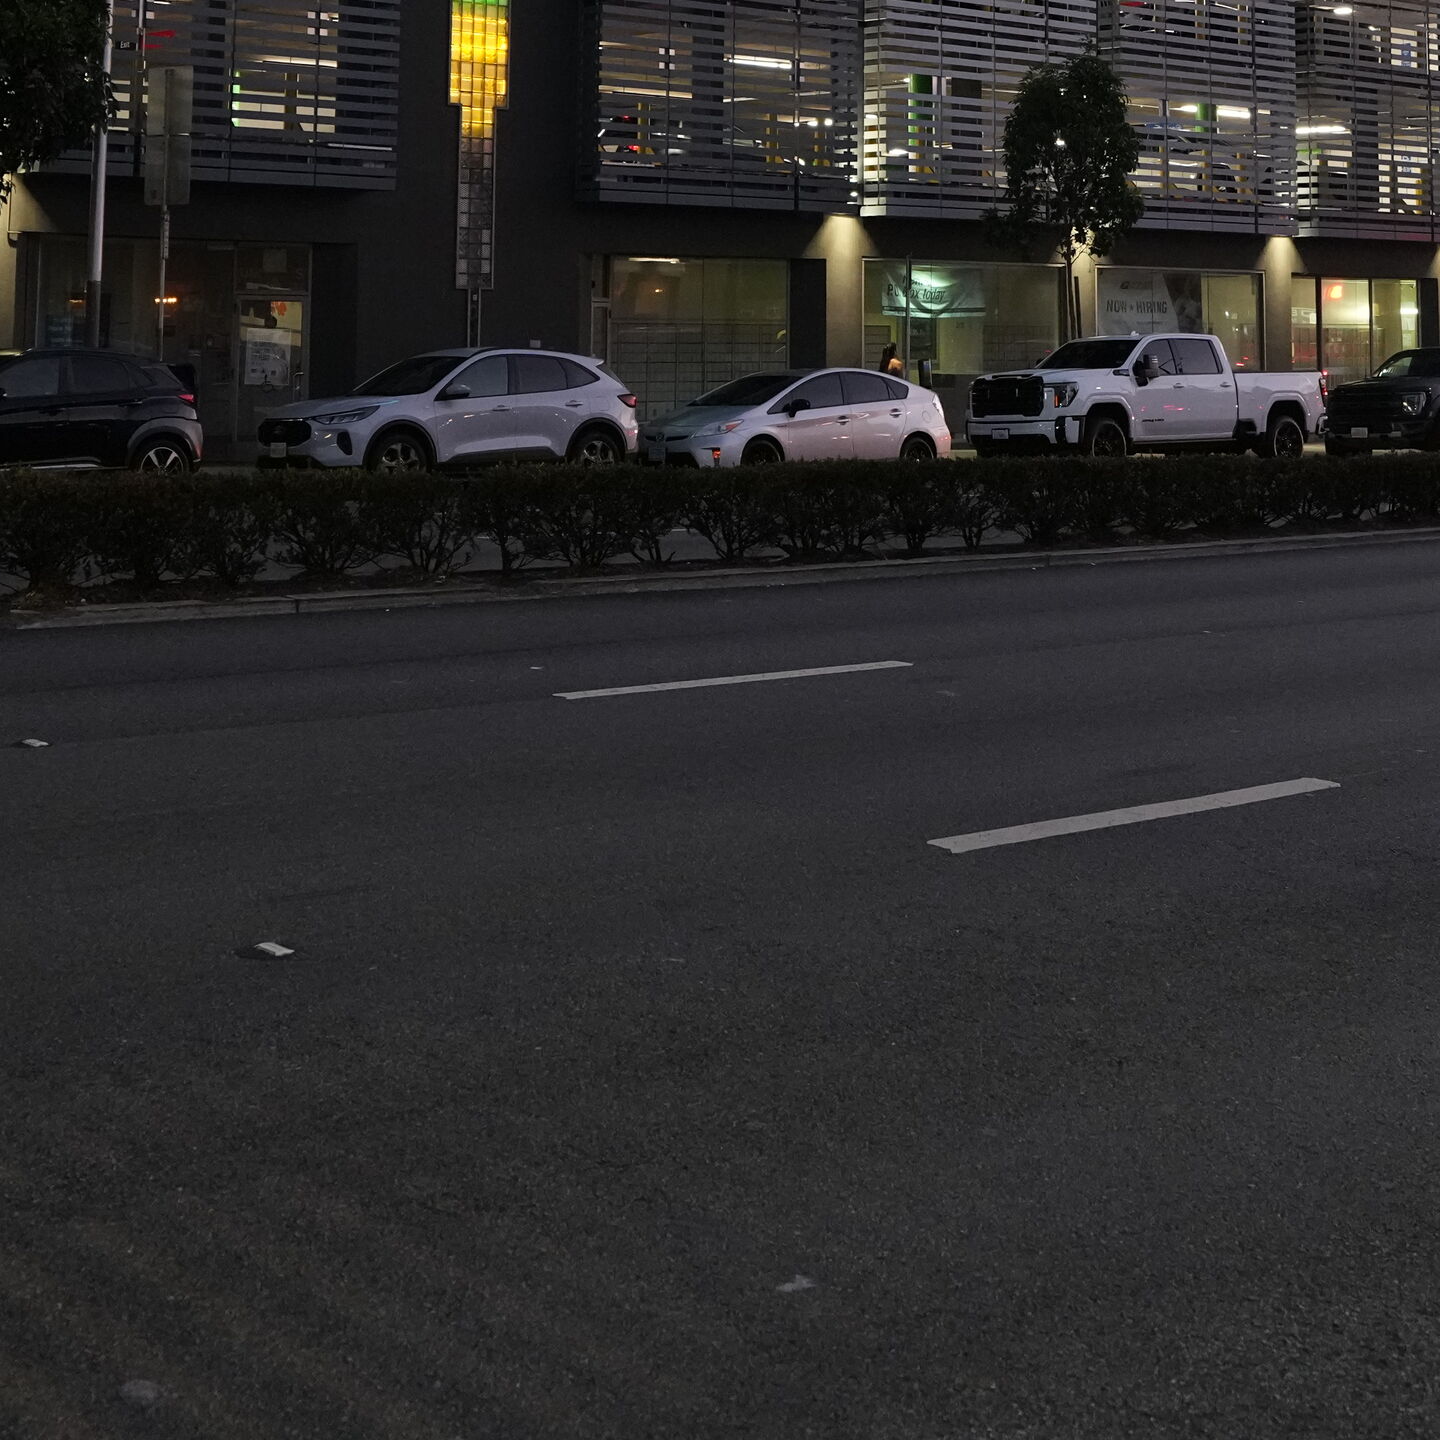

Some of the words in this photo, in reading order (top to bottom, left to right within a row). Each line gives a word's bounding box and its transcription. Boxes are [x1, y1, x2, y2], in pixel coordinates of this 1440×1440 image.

[922, 288, 946, 302] today
[1106, 299, 1127, 313] NOW
[1136, 300, 1168, 314] HIRING
